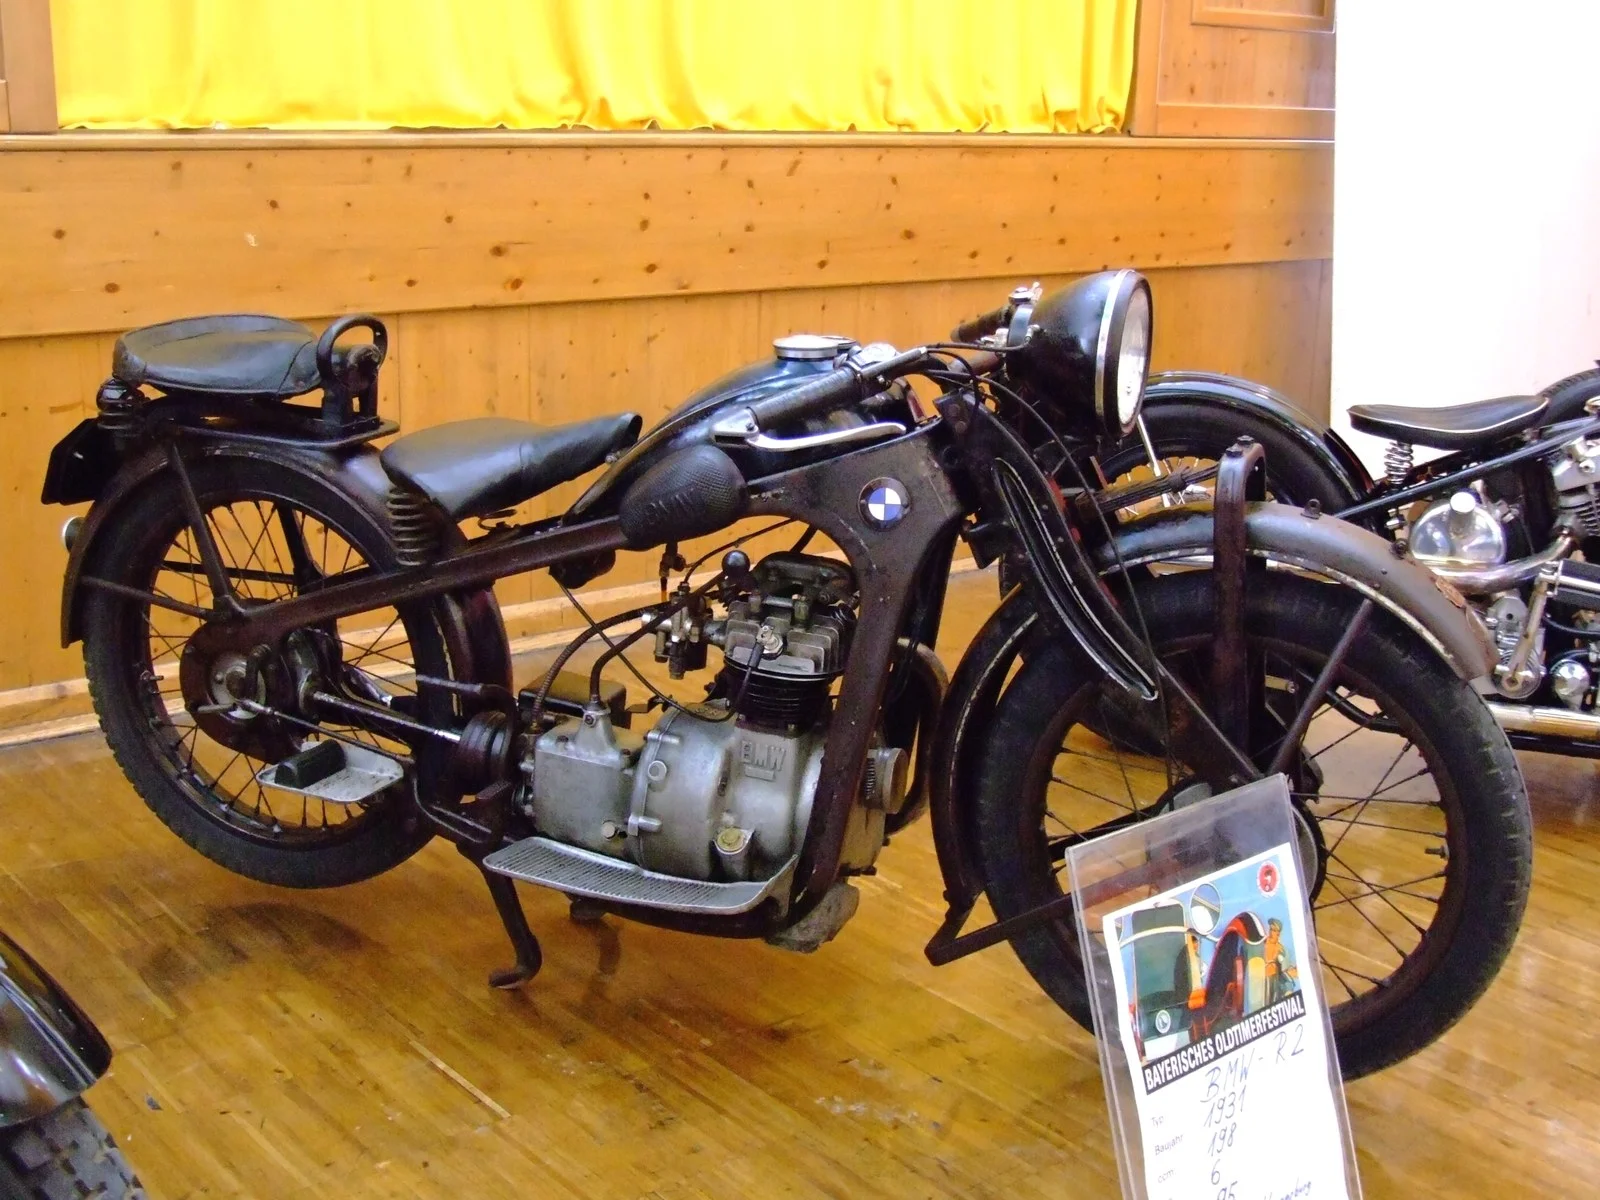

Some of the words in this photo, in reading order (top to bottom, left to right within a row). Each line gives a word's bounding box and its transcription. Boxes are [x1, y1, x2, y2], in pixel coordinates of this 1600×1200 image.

[741, 740, 786, 772] BMW
[1145, 1038, 1215, 1091] BAYERISCHES
[1215, 996, 1305, 1055] OLDTIMERFESTIVAL
[1200, 1048, 1255, 1102] BMW
[1204, 1085, 1247, 1128] 1931
[1154, 1134, 1184, 1156] Baujahr
[1208, 1122, 1237, 1156] 198
[1211, 1158, 1221, 1185] 6
